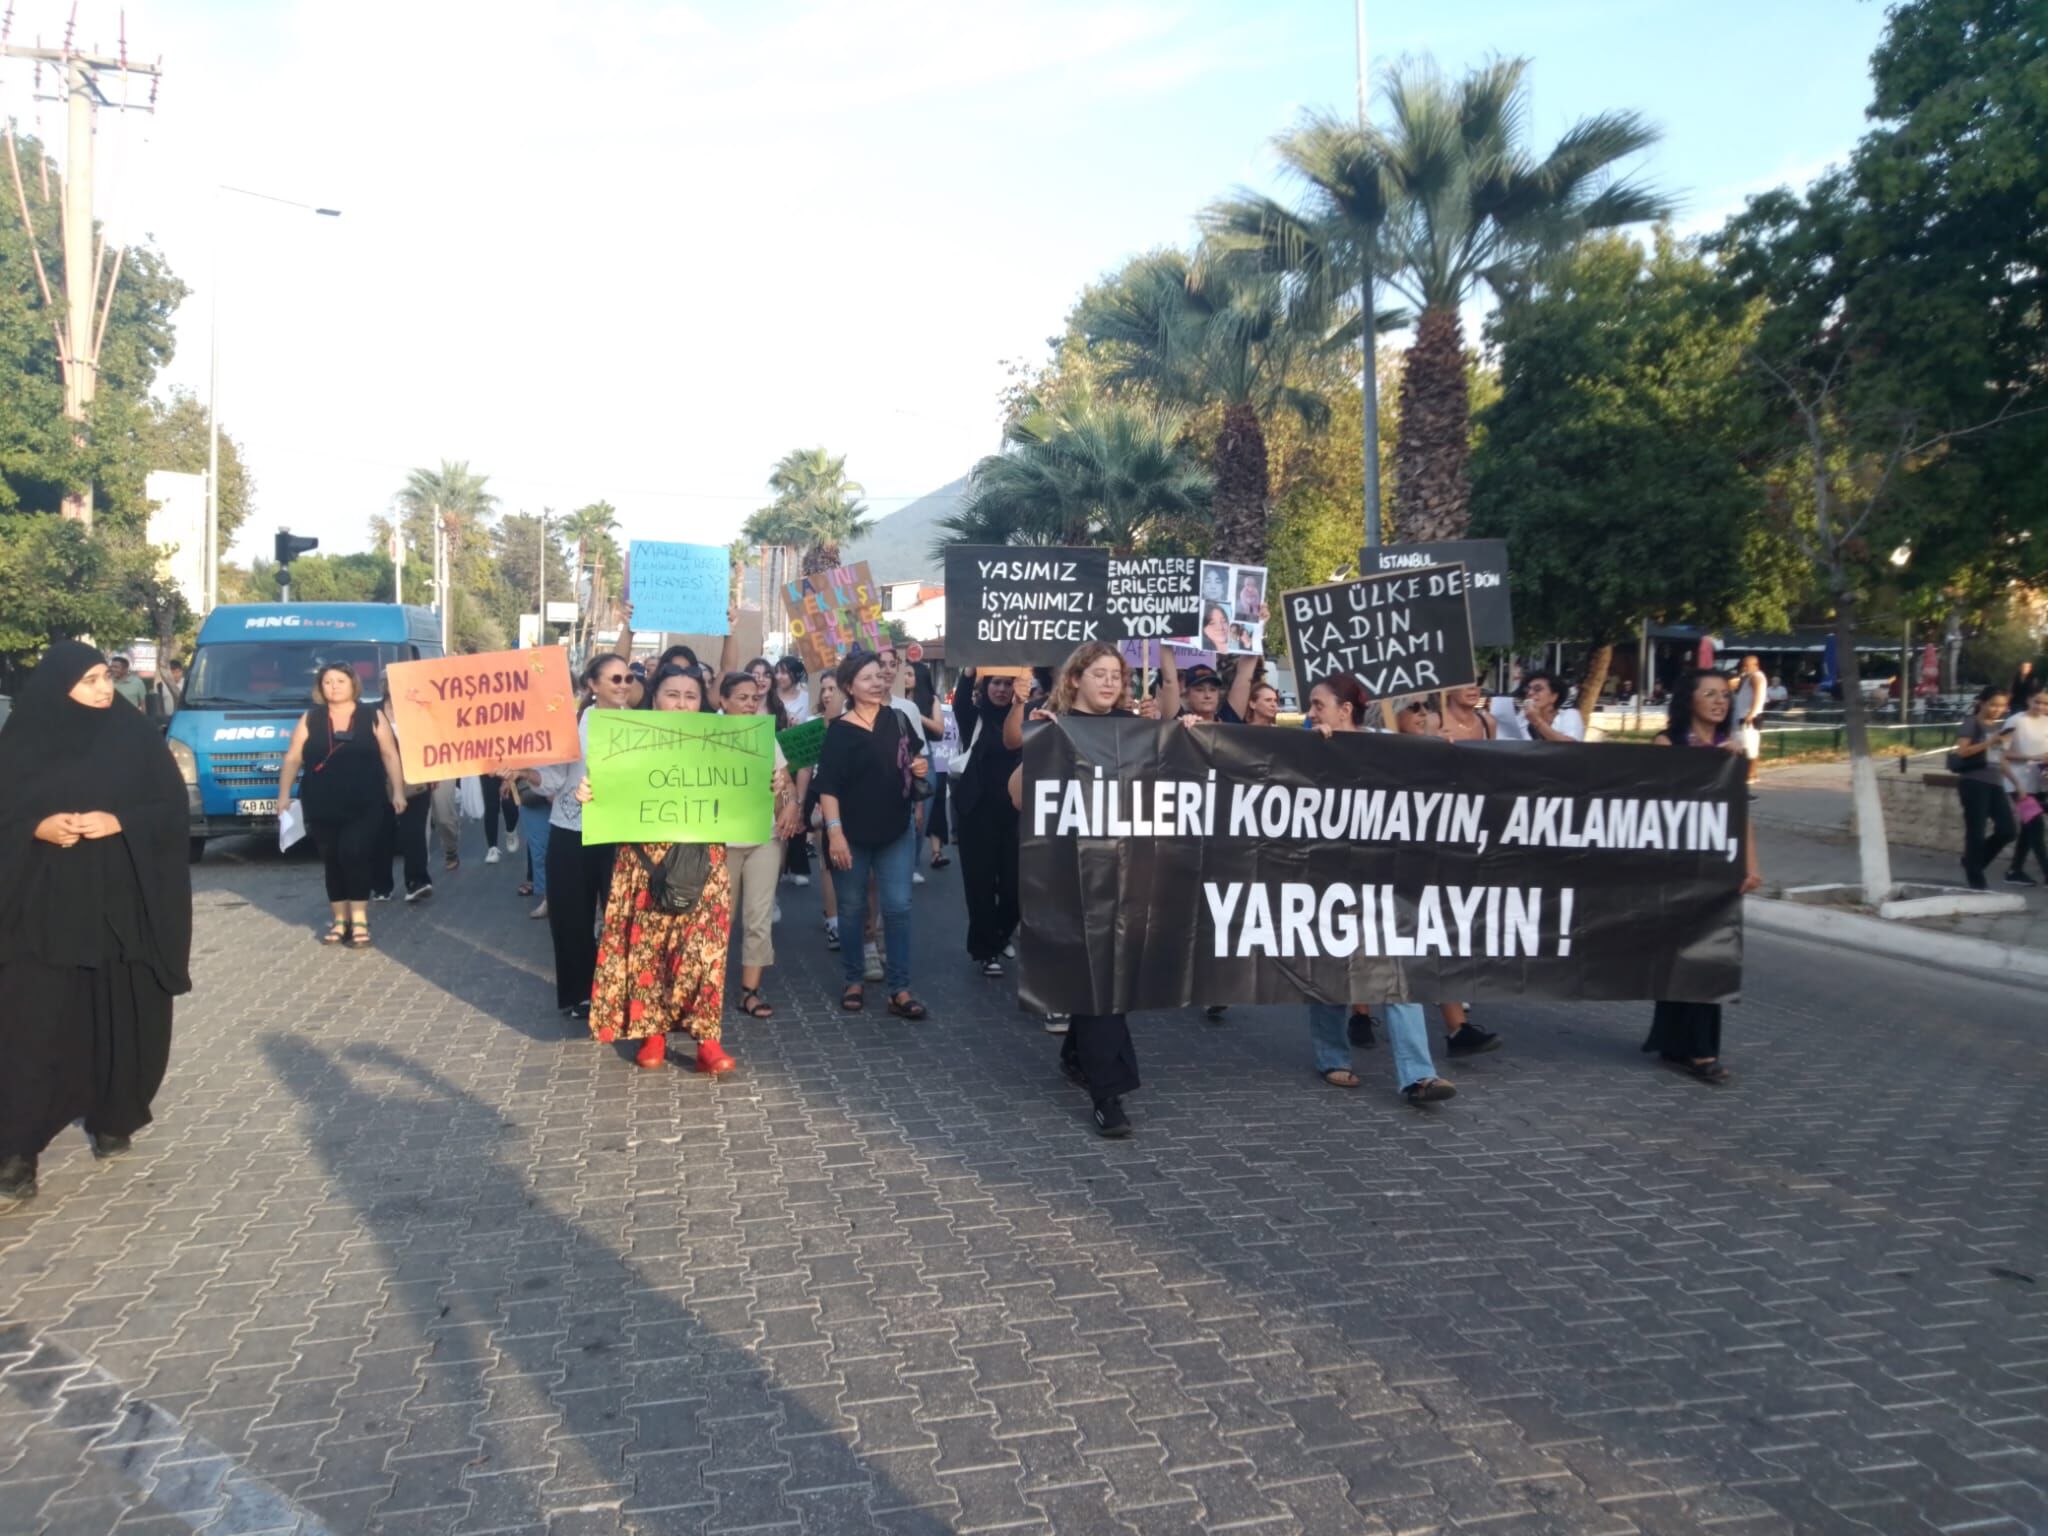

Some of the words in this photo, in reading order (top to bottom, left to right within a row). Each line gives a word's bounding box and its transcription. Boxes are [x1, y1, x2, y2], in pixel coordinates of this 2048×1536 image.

[978, 560, 1077, 581] YASIMIZ
[1107, 558, 1195, 577] EMAATLERE
[1379, 552, 1438, 569] İSTANBUL
[981, 586, 1093, 612] İSYANIMIZI
[1106, 594, 1200, 614] OCUĞUMUZ
[1293, 592, 1333, 622] BU
[245, 616, 300, 629] MNG
[978, 614, 1098, 642] BÜYÜTECEK
[1122, 614, 1173, 637] YOK
[1298, 608, 1411, 654] KADIN
[1304, 629, 1444, 682] KATLİAMI
[430, 670, 529, 701] YAŞASIN
[1355, 660, 1440, 696] VAR
[456, 700, 525, 728] KADIN
[214, 726, 276, 741] MNG
[423, 730, 552, 768] DAYANIŞMASI
[648, 765, 748, 789] OĞLUNU
[242, 801, 257, 811] 48
[1033, 765, 1216, 837] FAİLLERİ
[1229, 783, 1489, 854] KORUMAYIN,
[1499, 796, 1738, 862] AKLAMAYIN,
[1203, 882, 1542, 958] YARGILAYIN
